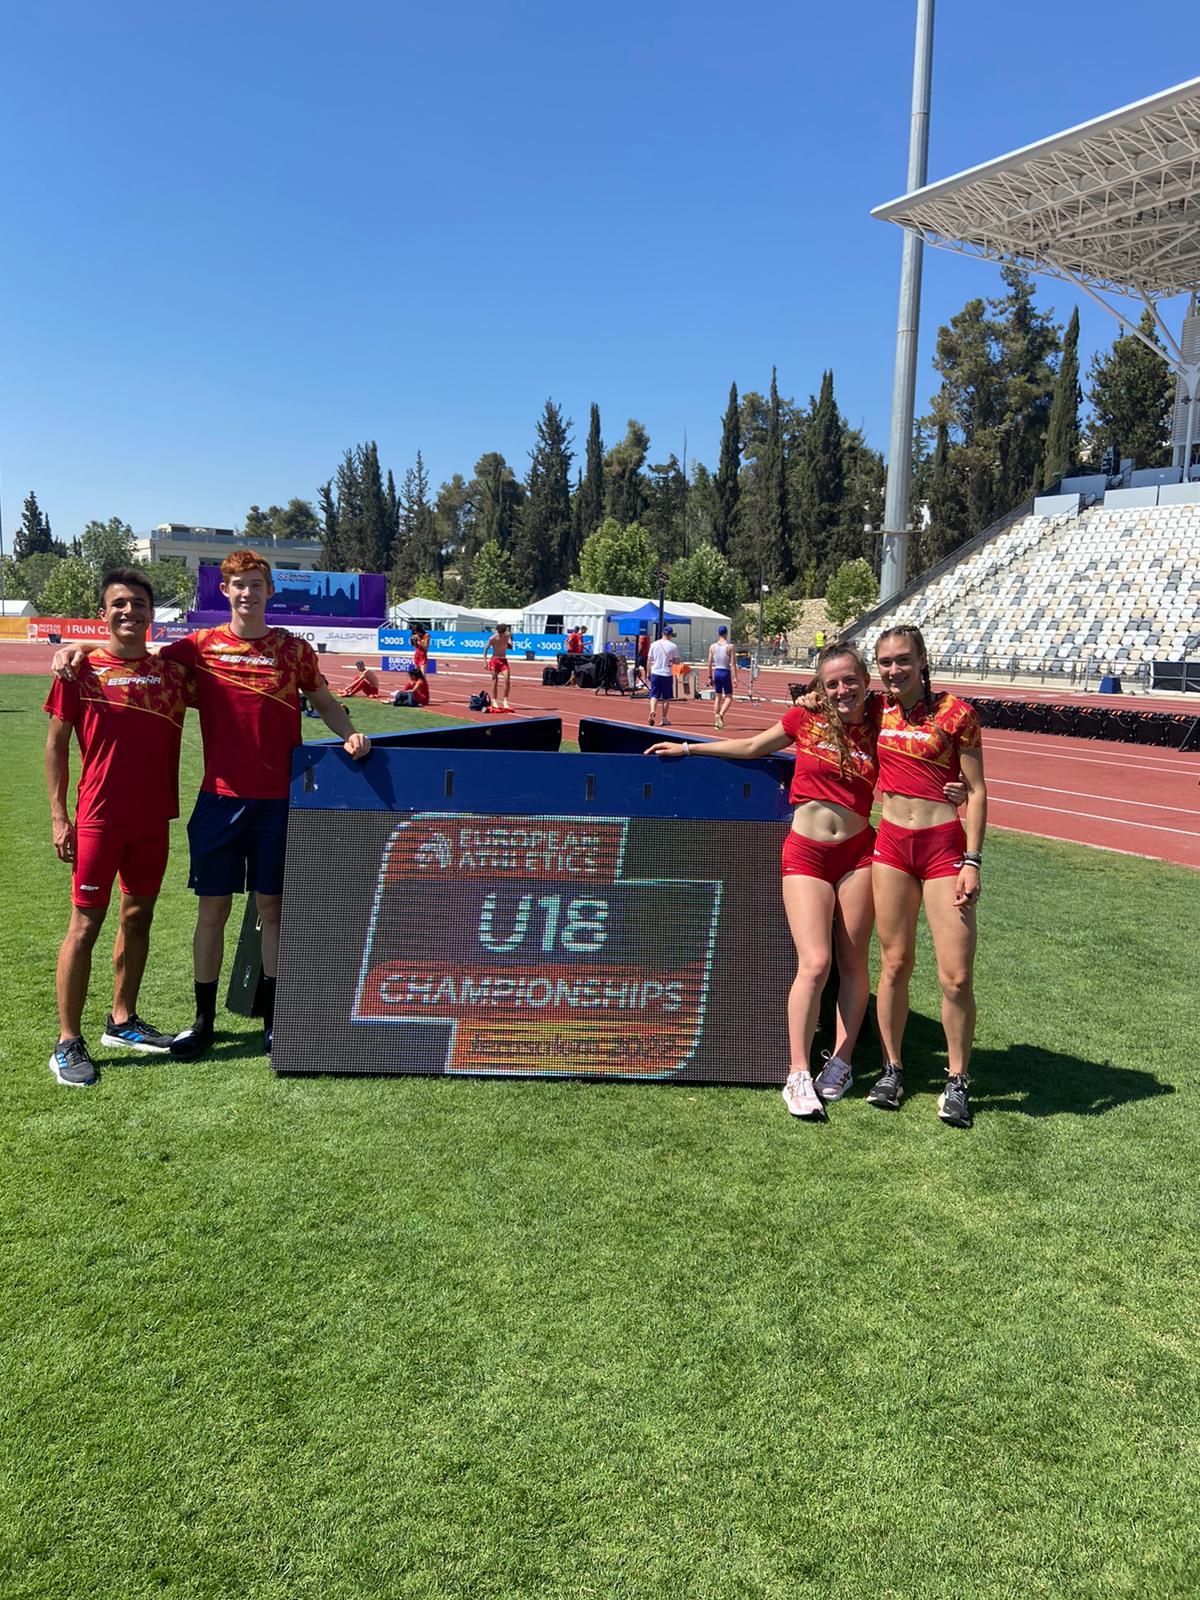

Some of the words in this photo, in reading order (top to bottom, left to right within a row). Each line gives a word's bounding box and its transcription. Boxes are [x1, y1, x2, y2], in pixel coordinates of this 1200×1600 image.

[67, 625, 71, 633] I
[72, 625, 95, 634] RUN
[98, 626, 111, 635] CL
[219, 654, 274, 665] ESPAÑA
[107, 675, 161, 686] ESPAÑA
[459, 828, 600, 850] EUROPEAN
[458, 851, 598, 873] ATHLETICS
[478, 893, 609, 953] U18
[379, 974, 684, 1011] CHAMPIONSHIPS
